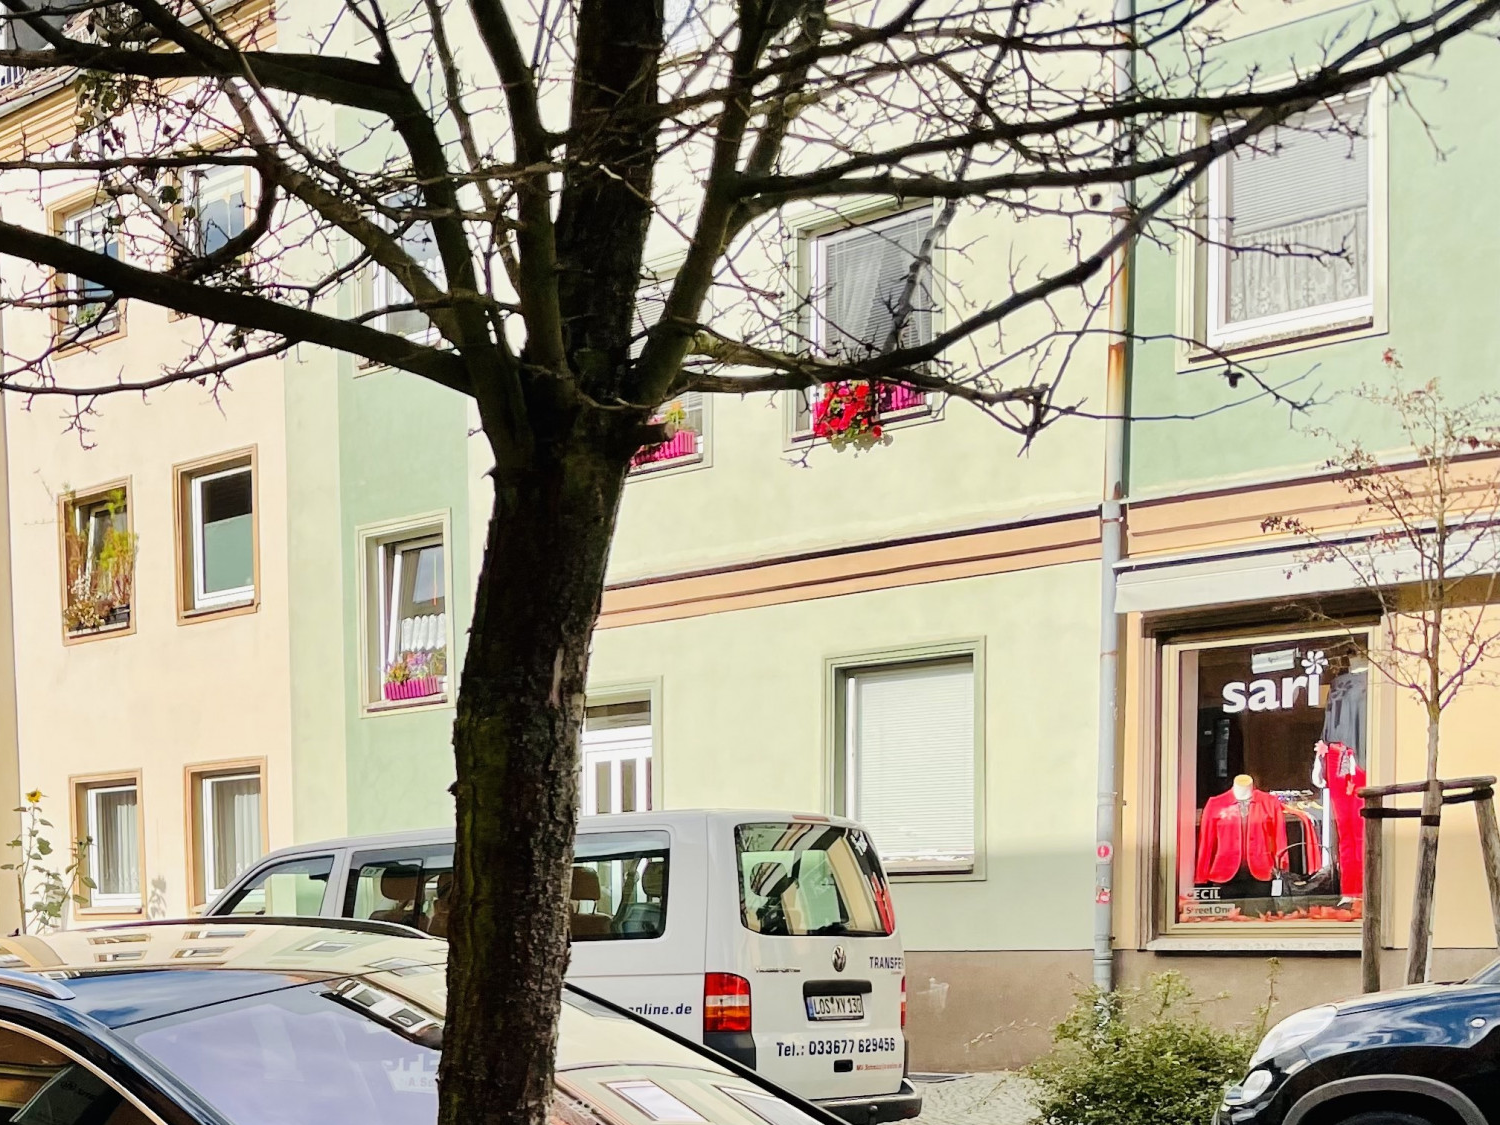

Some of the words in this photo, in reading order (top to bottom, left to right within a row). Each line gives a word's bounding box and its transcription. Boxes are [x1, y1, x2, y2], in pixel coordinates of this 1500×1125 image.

[1222, 655, 1323, 713] sari
[813, 996, 831, 1016] LOS
[835, 996, 847, 1015] XY
[776, 1041, 805, 1057] Tel.:
[808, 1039, 855, 1056] 033677
[858, 1037, 896, 1054] 629456
